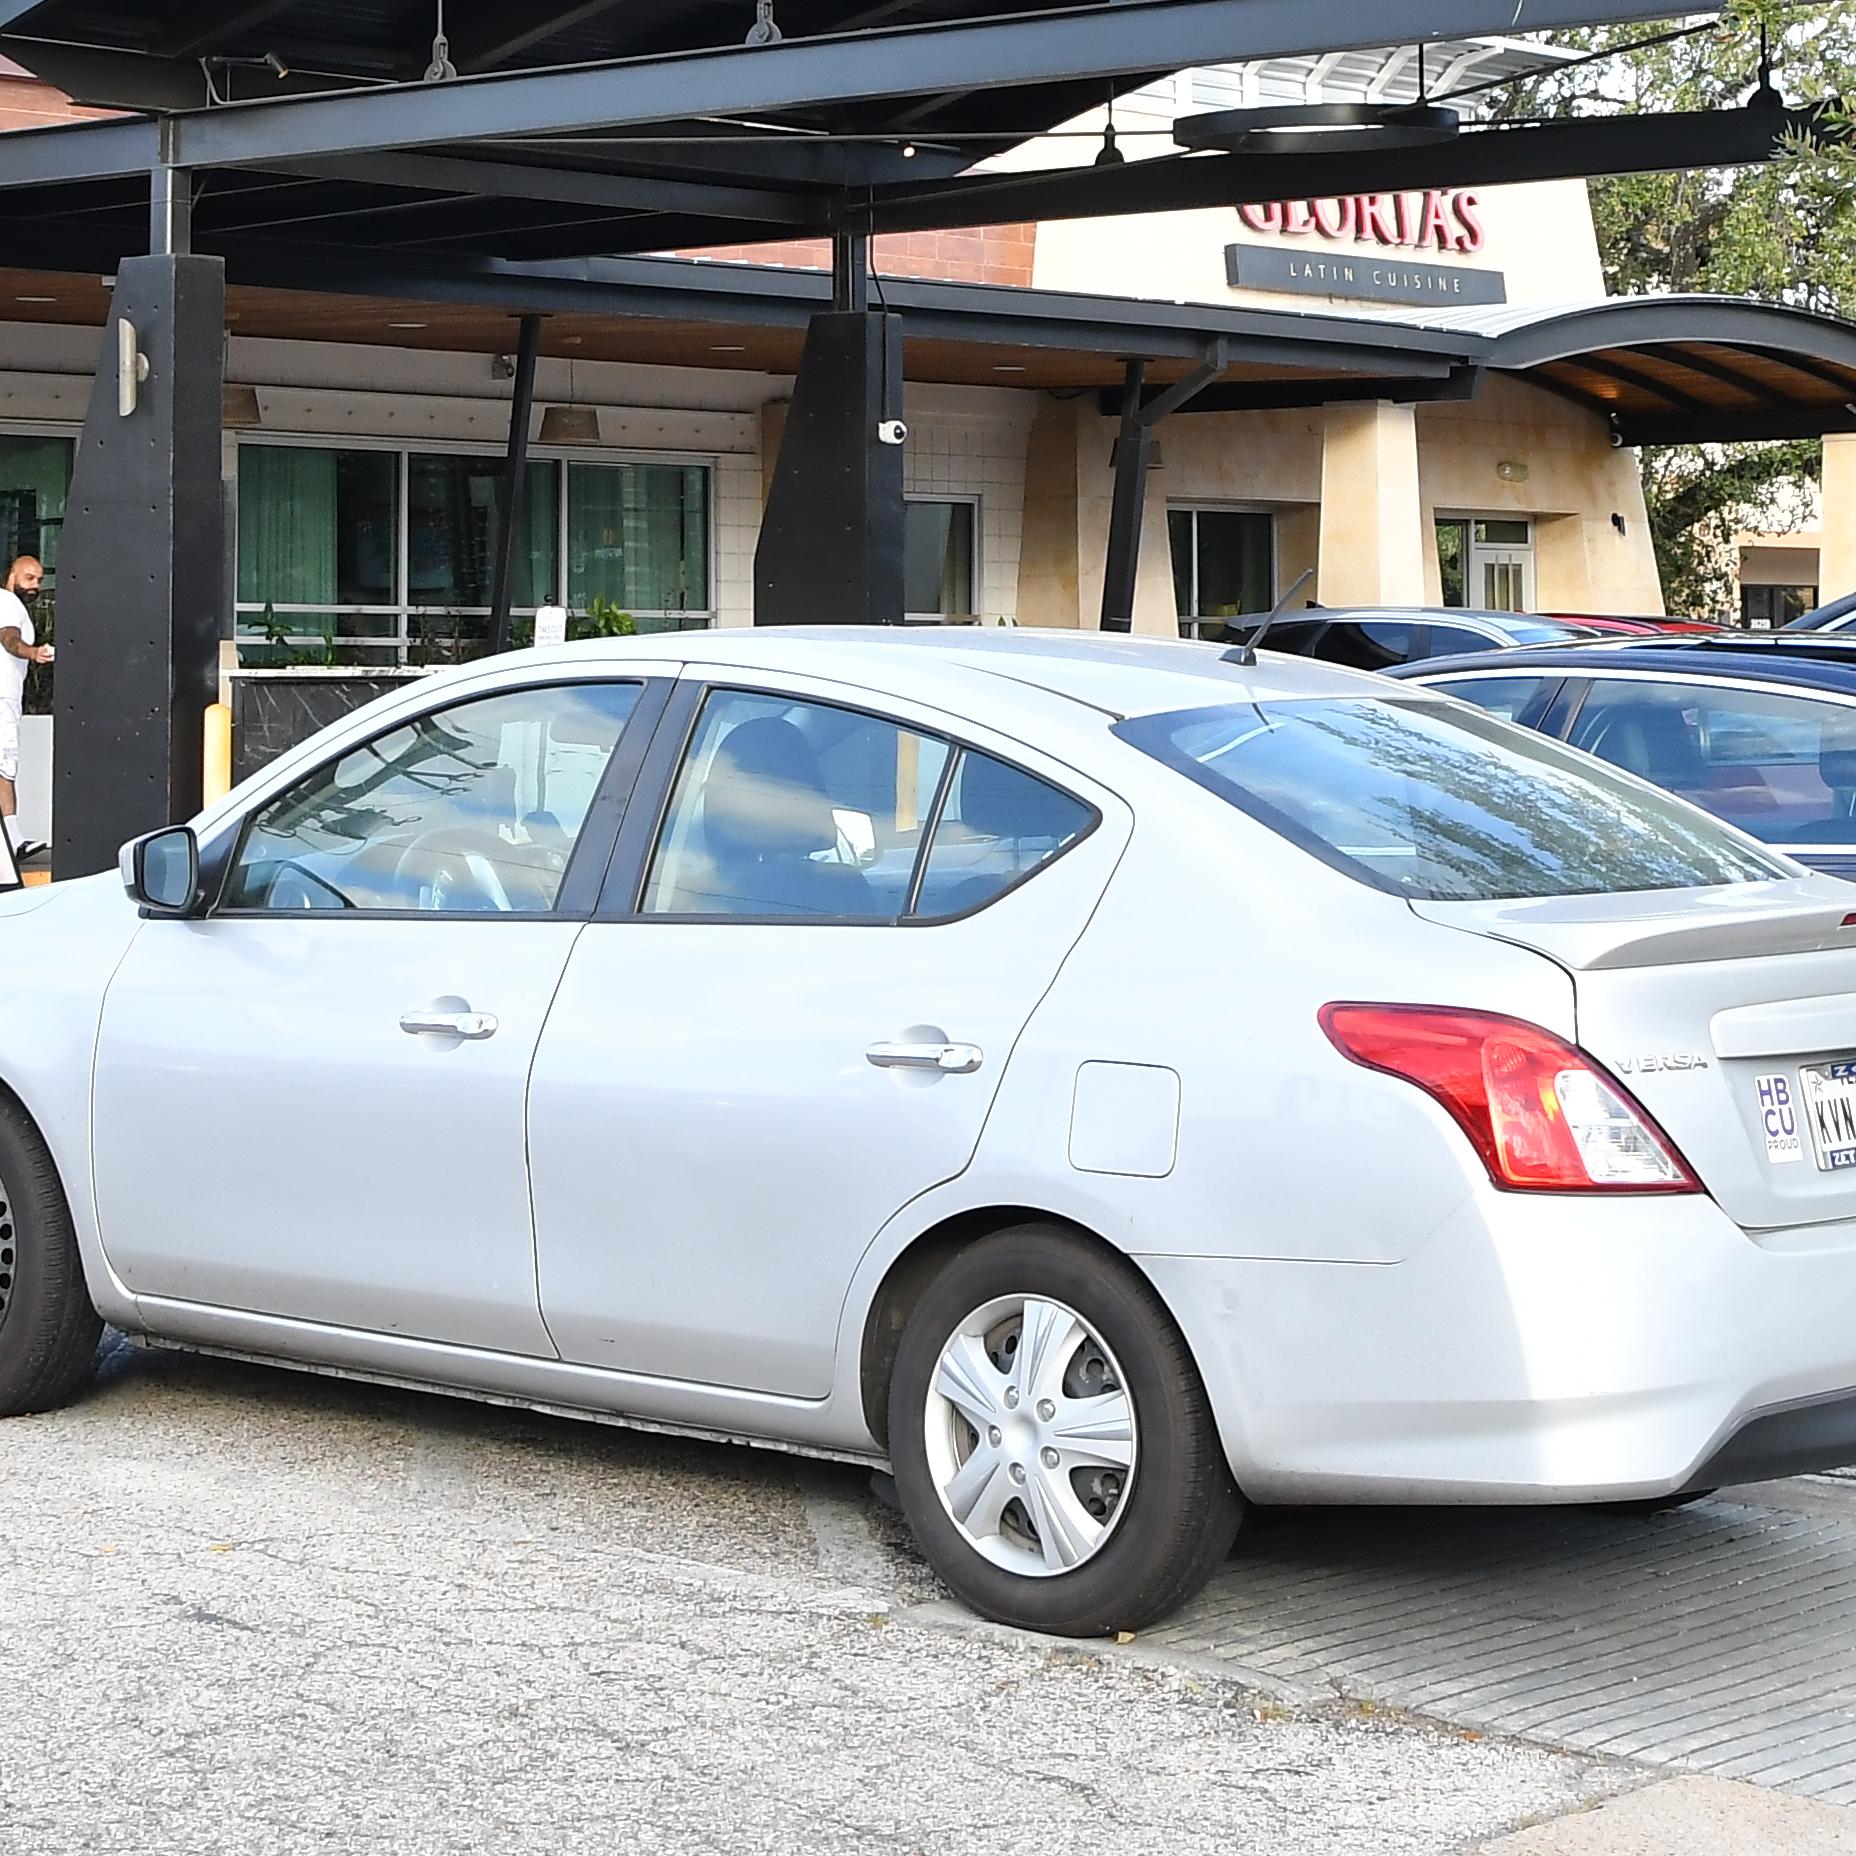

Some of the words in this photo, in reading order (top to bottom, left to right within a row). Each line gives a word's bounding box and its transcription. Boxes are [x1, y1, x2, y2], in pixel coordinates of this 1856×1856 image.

[1289, 262, 1354, 283] LATIN
[1373, 270, 1462, 293] CUISINE
[1614, 1052, 1709, 1075] VERSA
[1768, 1138, 1799, 1151] PROUD
